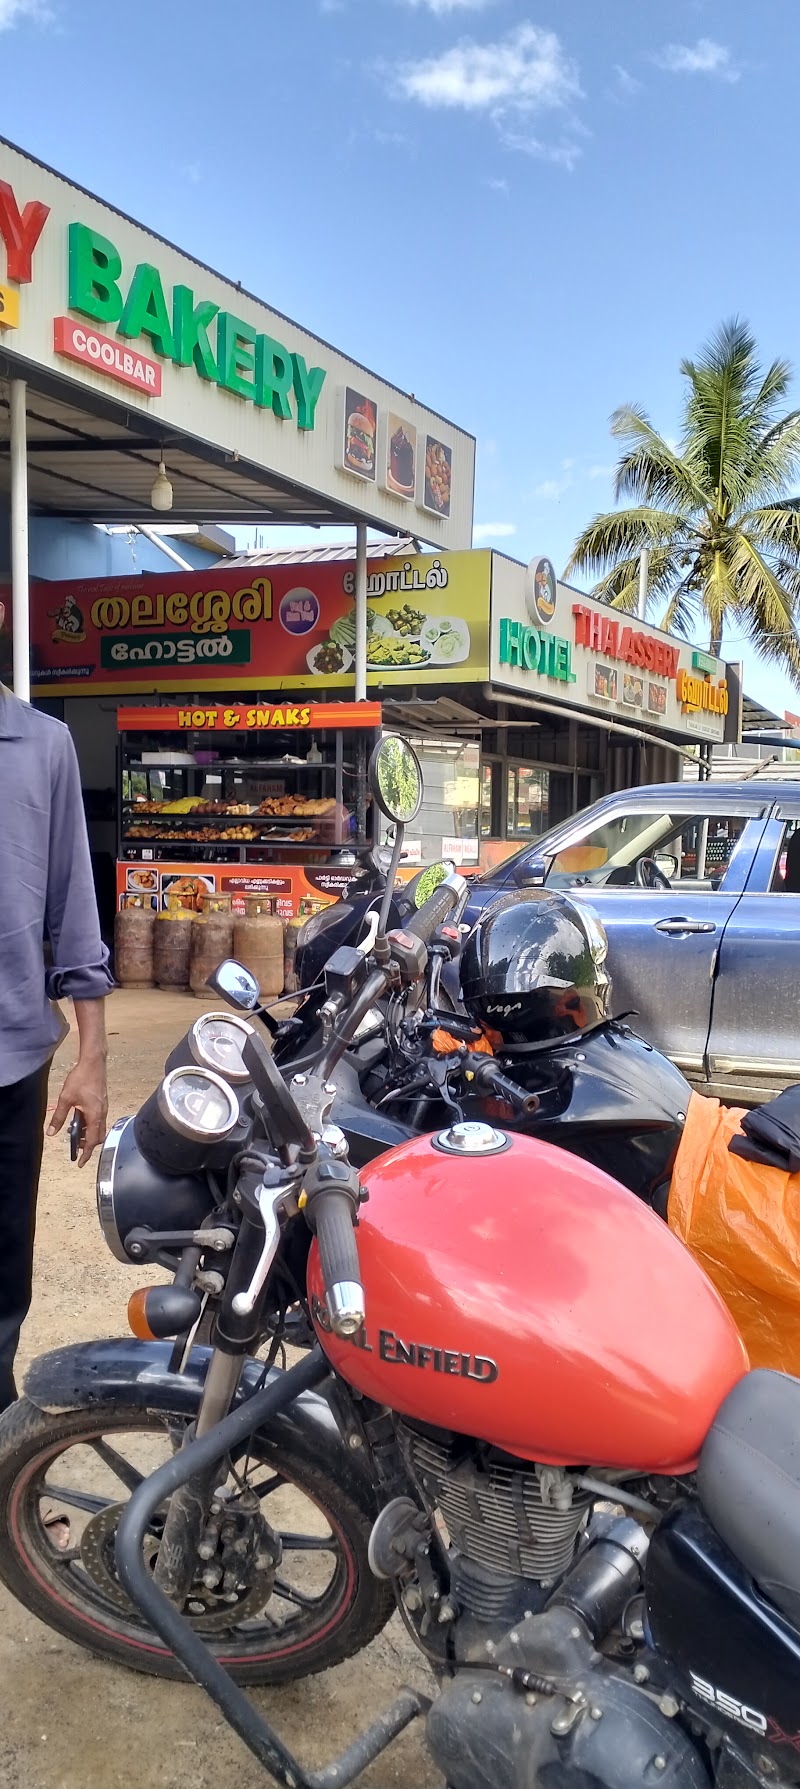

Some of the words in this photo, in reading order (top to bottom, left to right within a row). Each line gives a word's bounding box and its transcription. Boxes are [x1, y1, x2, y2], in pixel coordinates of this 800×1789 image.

[68, 222, 327, 431] BAKERY
[72, 328, 156, 388] COOLBAR
[91, 577, 272, 634] തലശ്ശേരി
[111, 635, 233, 662] ഹോട്ടൽ
[499, 618, 577, 683] HOTEL
[572, 603, 680, 679] THALASSERY
[178, 710, 218, 728] HOT
[223, 709, 240, 728] &
[245, 708, 310, 727] SNAKS
[689, 1670, 767, 1731] 350
